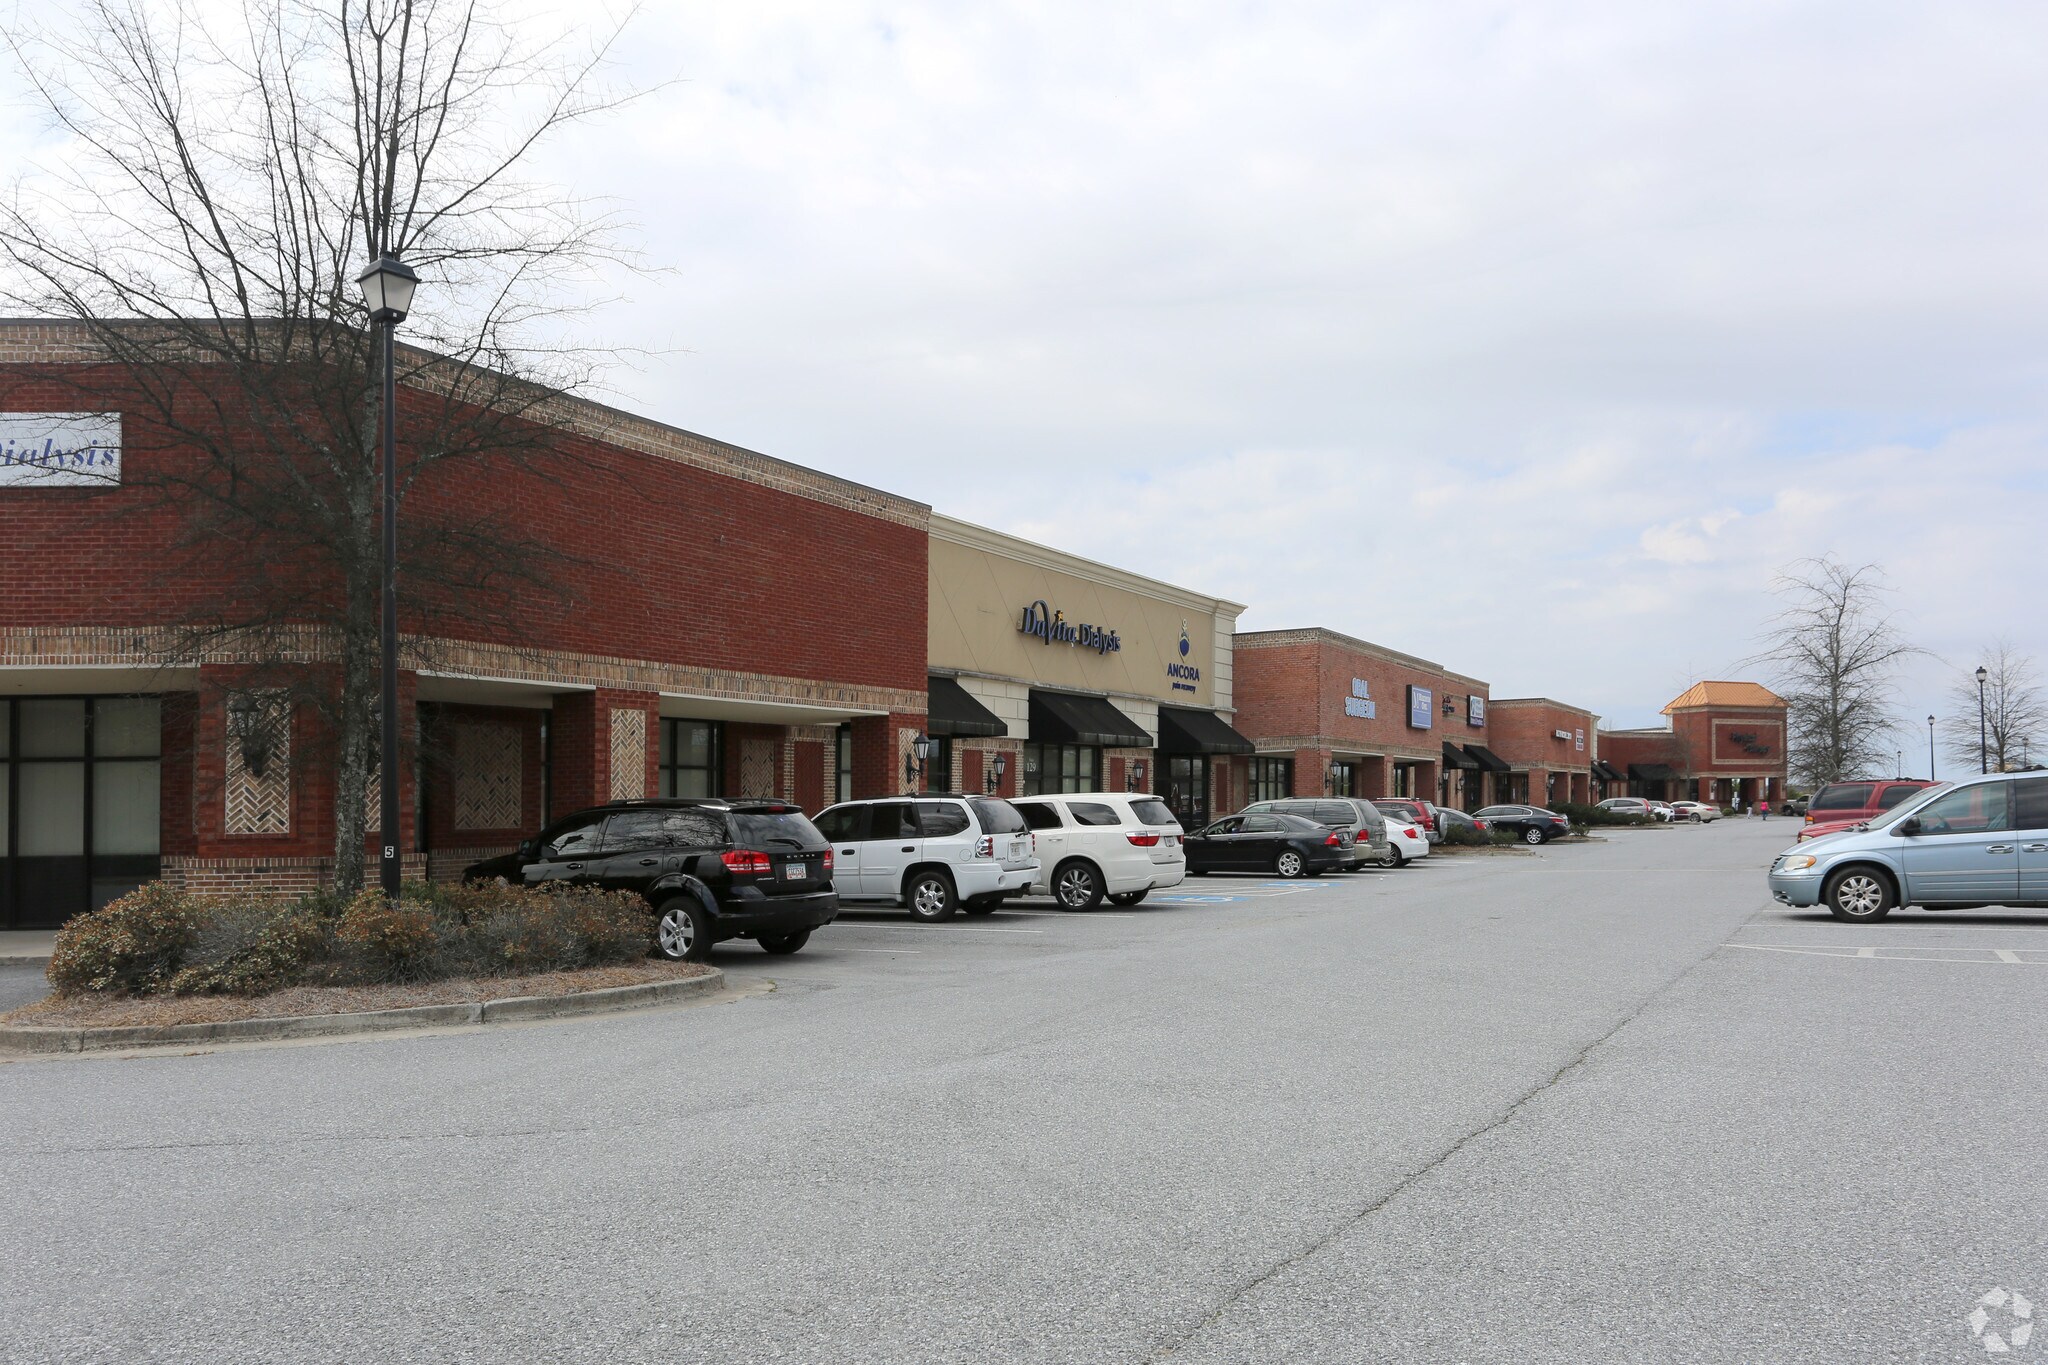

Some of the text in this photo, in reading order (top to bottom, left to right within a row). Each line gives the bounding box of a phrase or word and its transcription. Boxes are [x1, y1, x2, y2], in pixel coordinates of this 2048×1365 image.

[0, 438, 115, 474] ialysis
[1020, 599, 1121, 655] DaVita Dialysis
[1166, 662, 1200, 682] ANCORA
[385, 846, 394, 857] 5
